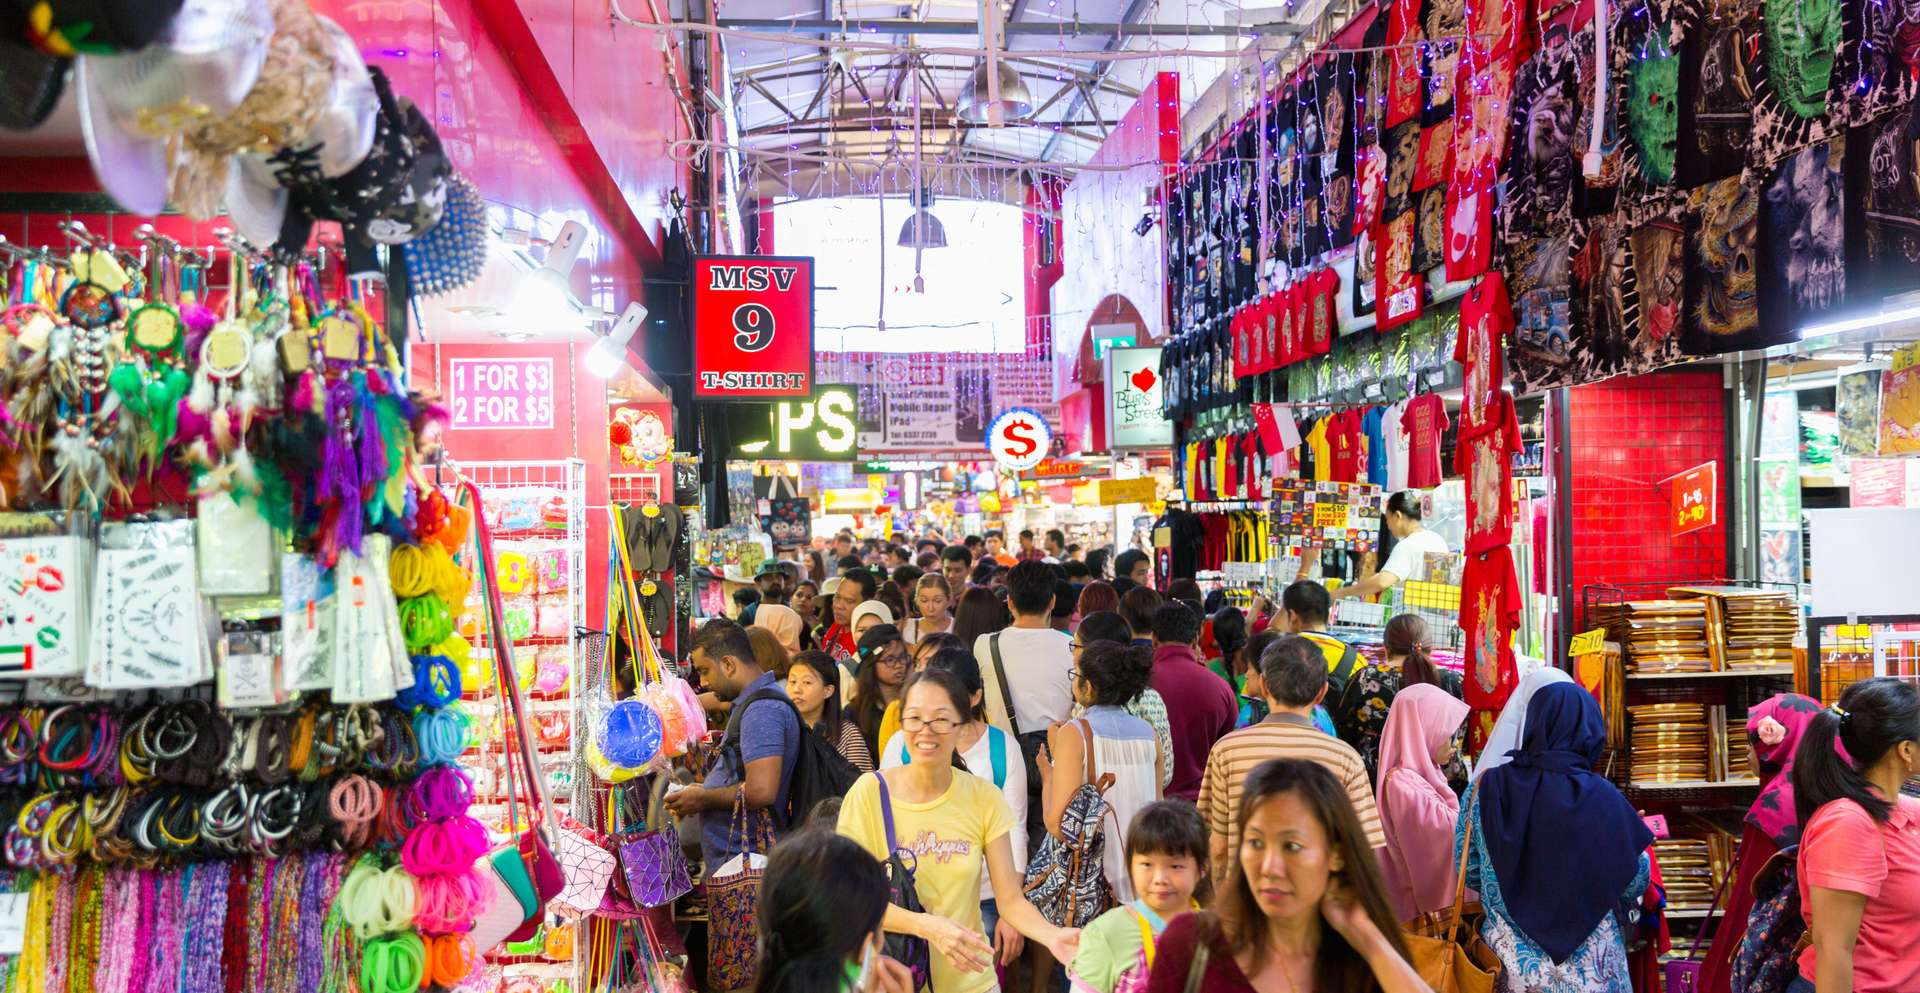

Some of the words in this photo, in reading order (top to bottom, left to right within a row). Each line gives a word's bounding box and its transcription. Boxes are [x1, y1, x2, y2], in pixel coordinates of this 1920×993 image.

[710, 265, 797, 292] MSV
[732, 303, 776, 353] 9
[455, 365, 465, 392] 1
[473, 364, 520, 392] FOR
[525, 363, 549, 394] $3
[701, 371, 805, 390] T-SHIRT
[1122, 371, 1131, 392] I
[455, 396, 468, 423] 2
[473, 396, 520, 423] FOR
[525, 394, 550, 425] $5
